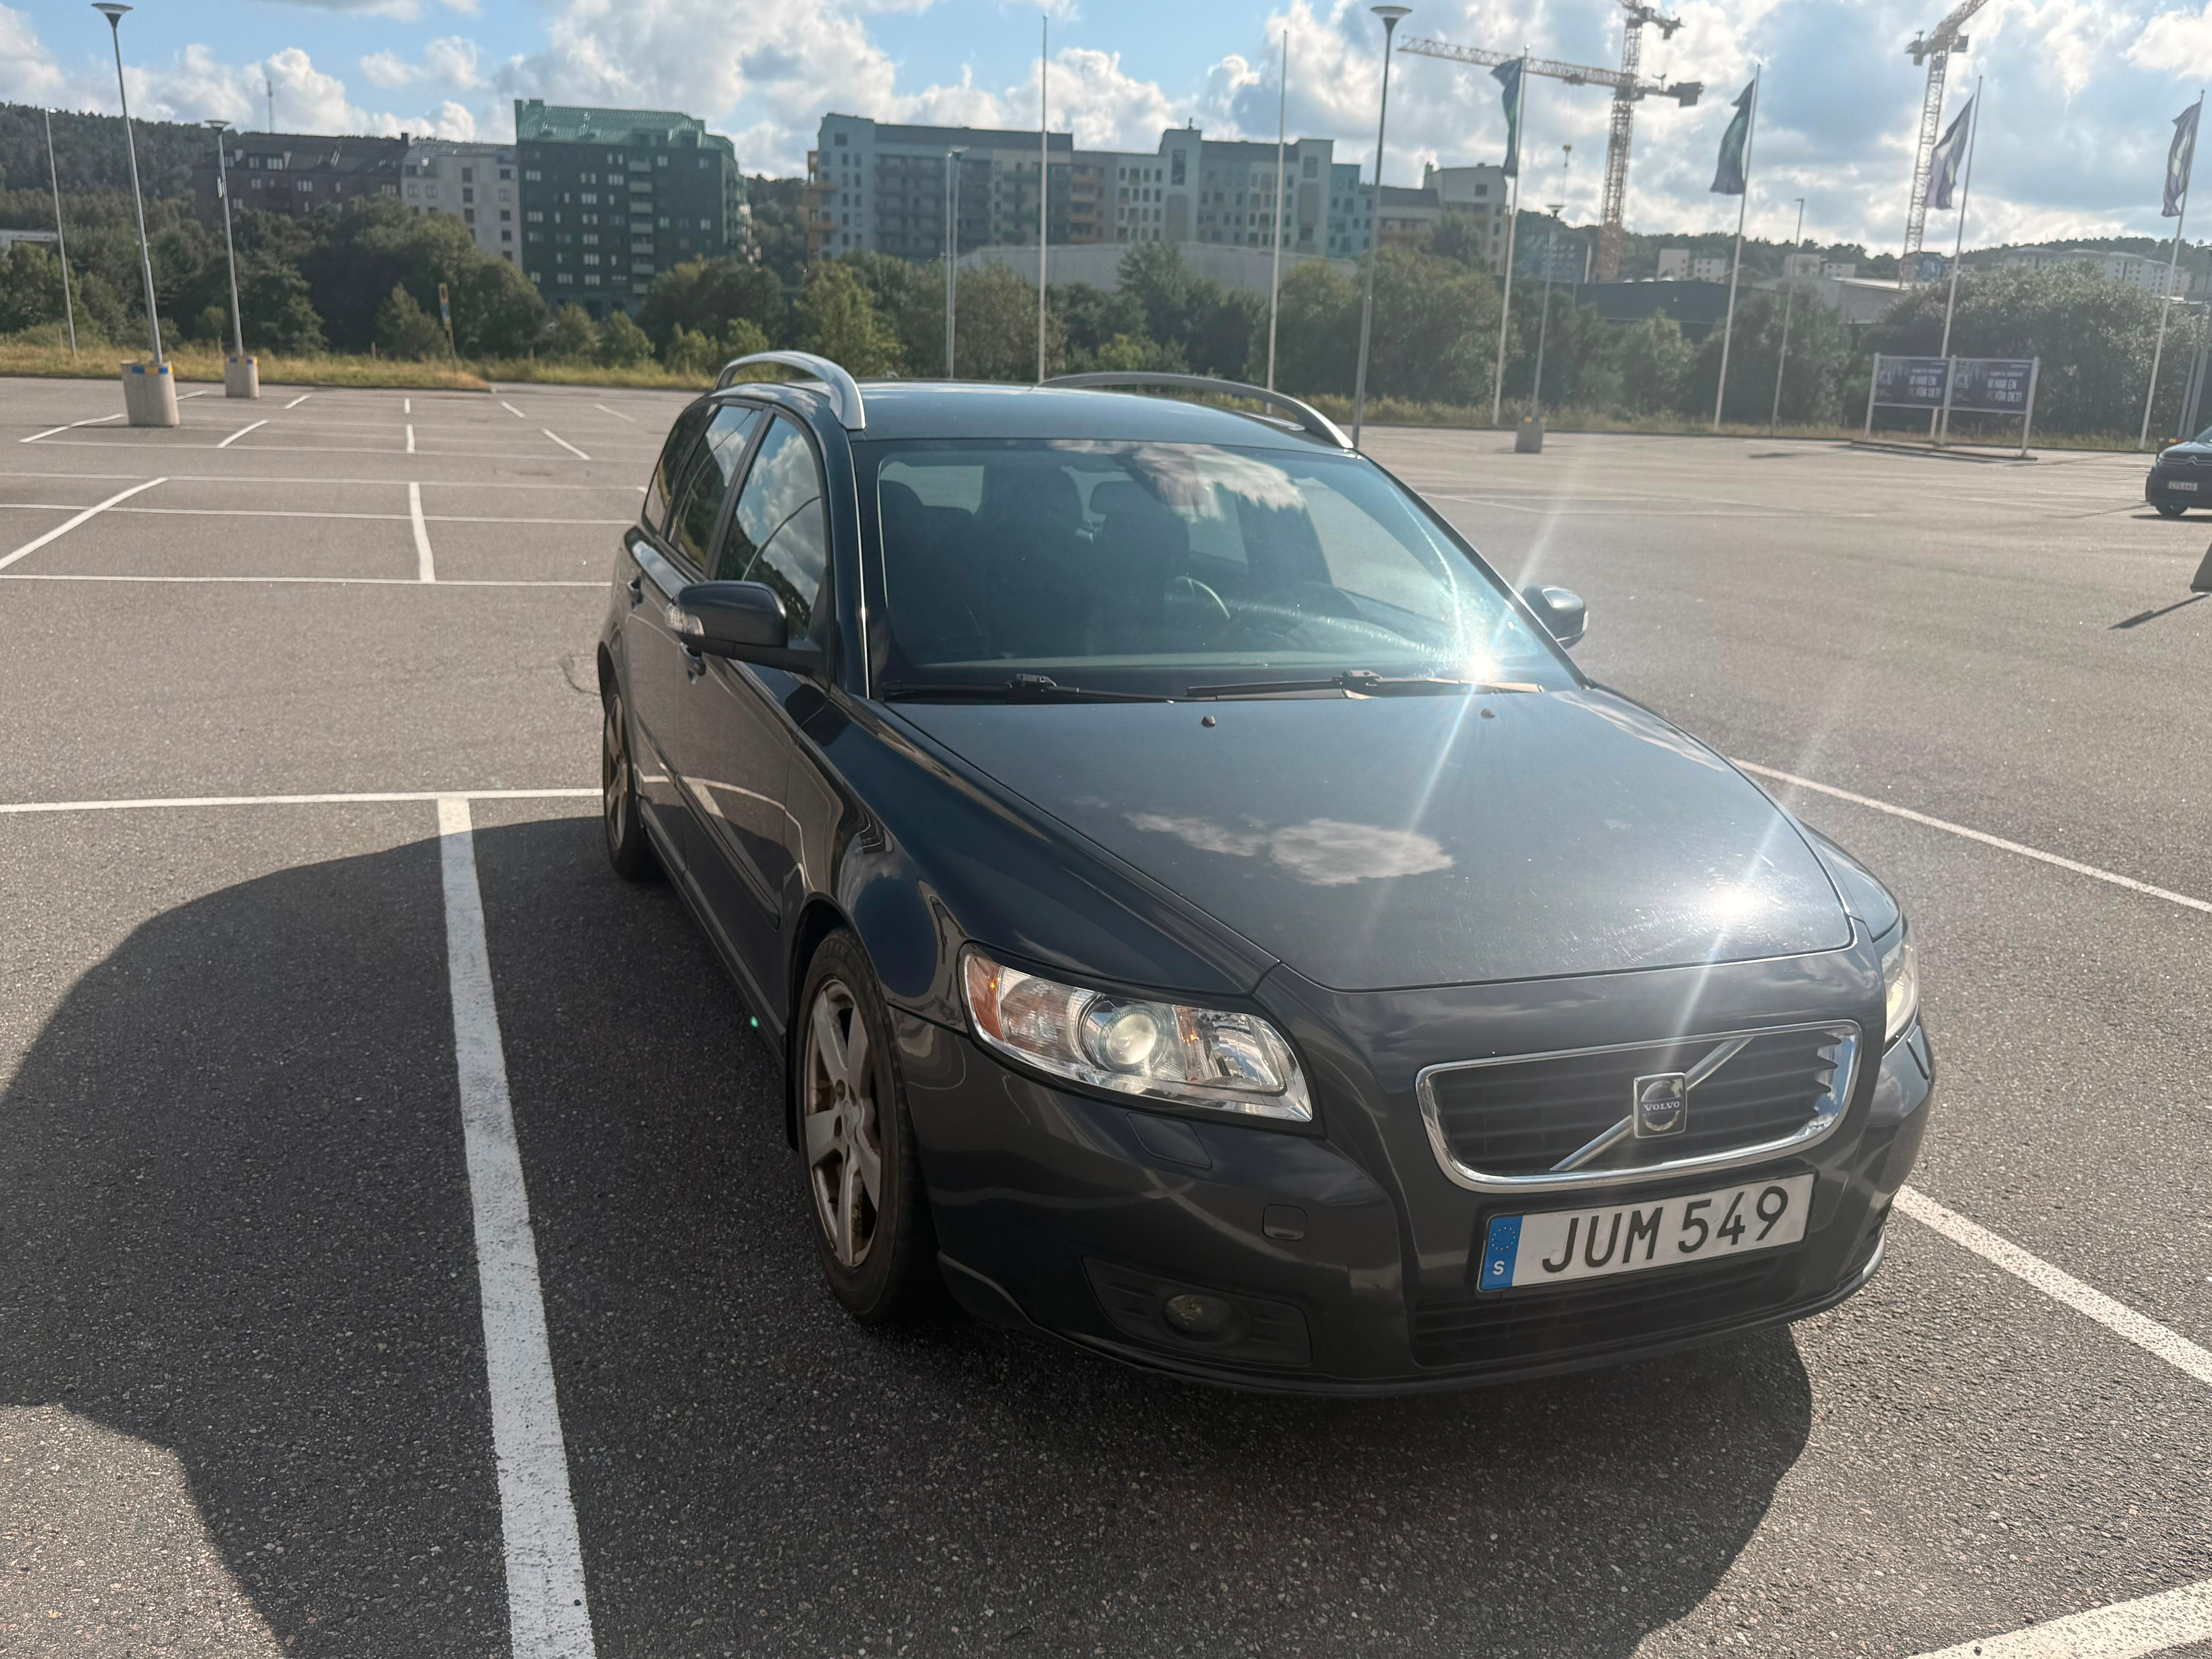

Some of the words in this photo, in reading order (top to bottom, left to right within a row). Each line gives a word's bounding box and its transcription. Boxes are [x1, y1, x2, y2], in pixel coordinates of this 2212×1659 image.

[1643, 1101, 1680, 1111] VOLVO
[1542, 1207, 1663, 1273] JUM
[1678, 1185, 1789, 1253] 549
[1493, 1260, 1505, 1275] S
